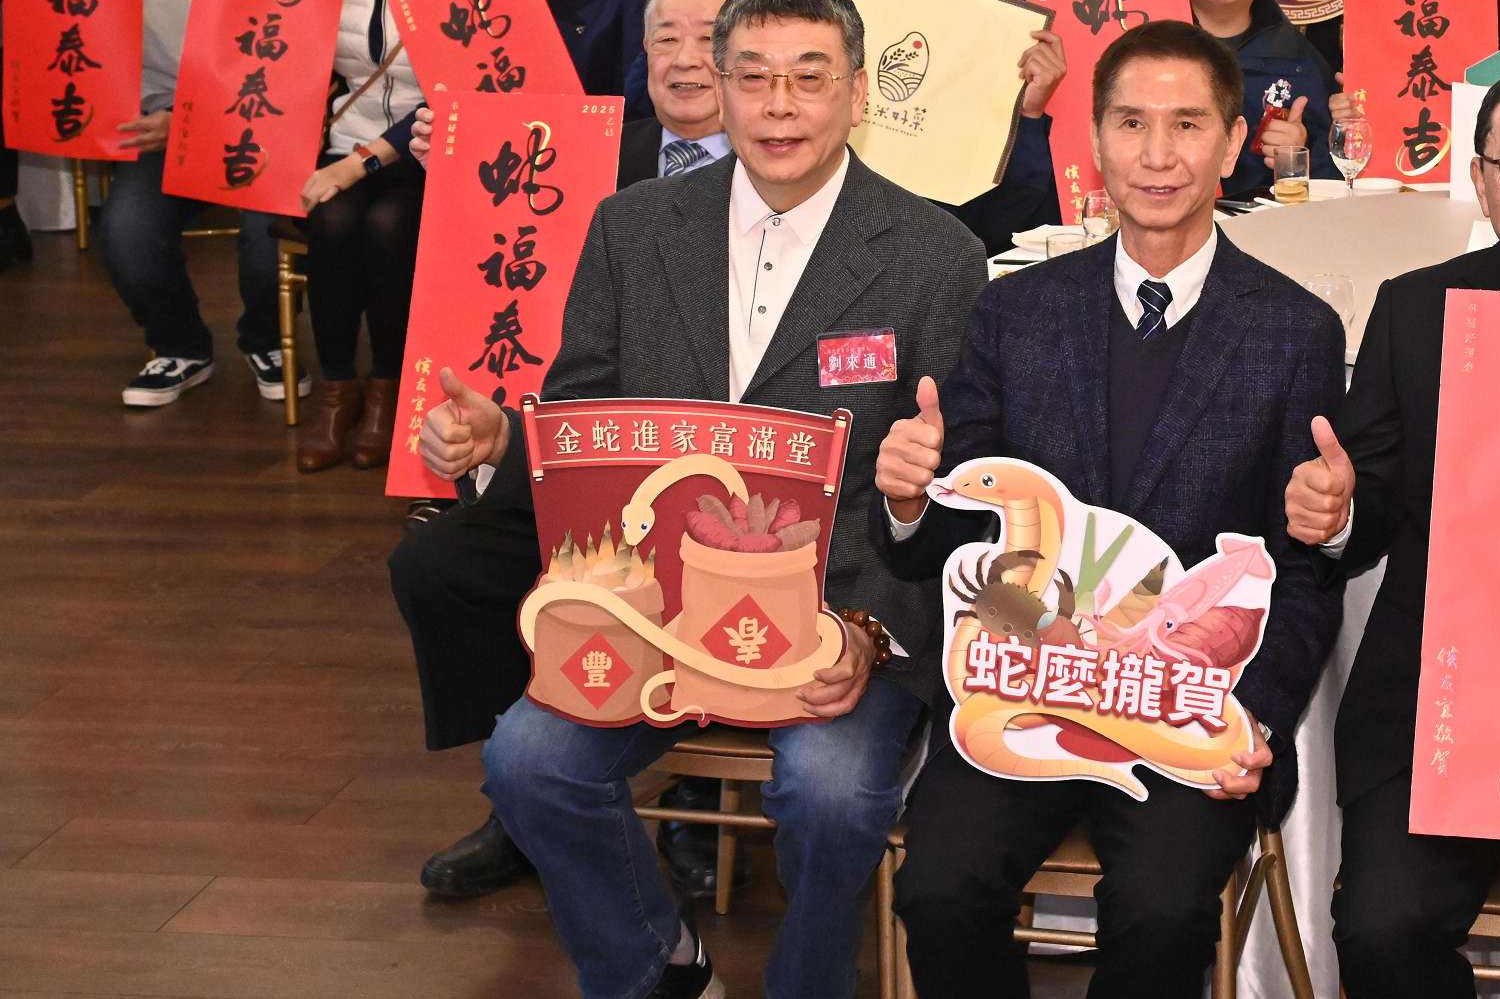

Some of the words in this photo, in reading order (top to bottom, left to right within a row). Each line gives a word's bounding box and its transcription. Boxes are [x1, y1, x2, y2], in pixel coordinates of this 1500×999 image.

[582, 104, 616, 114] 2025
[828, 353, 877, 372] 劉來通
[553, 419, 816, 467] 金蛇進家富滿堂
[581, 650, 612, 689] 豐
[964, 630, 1232, 730] 蛇麼攏賀
